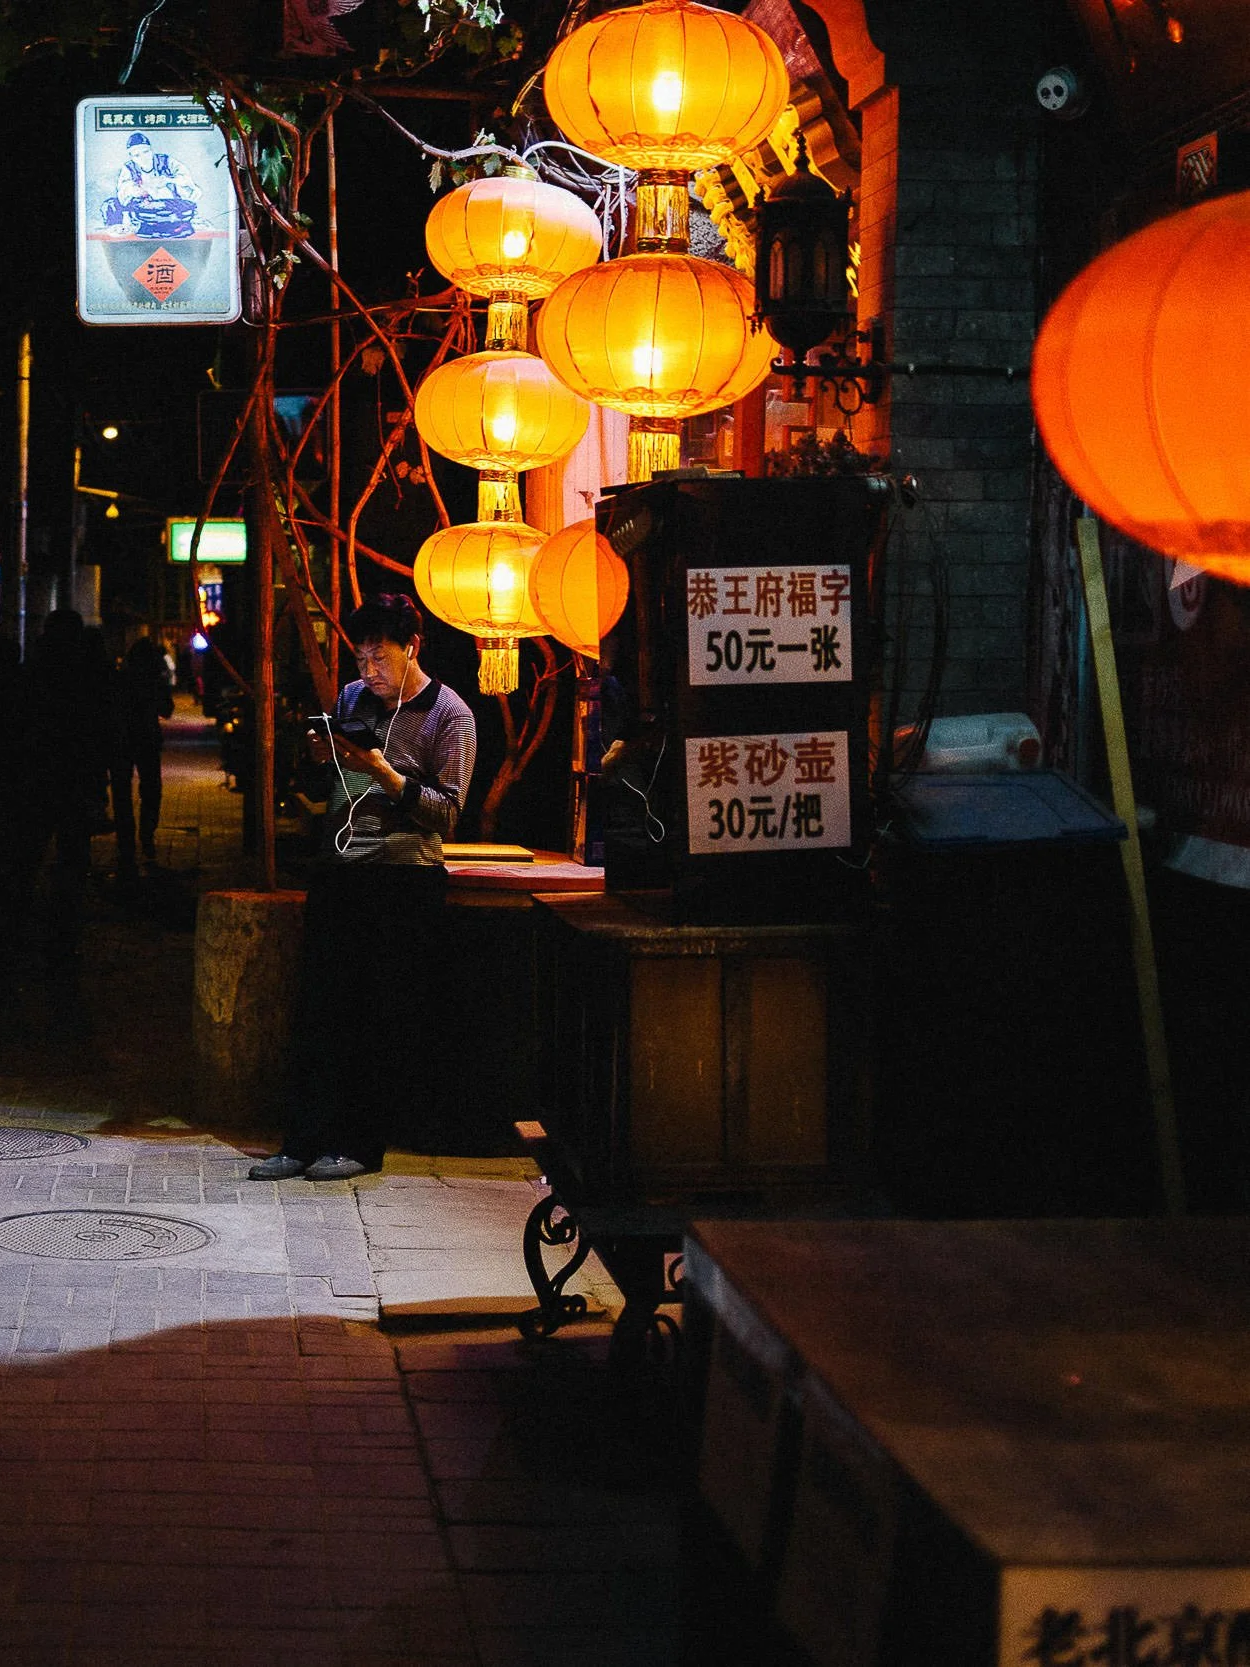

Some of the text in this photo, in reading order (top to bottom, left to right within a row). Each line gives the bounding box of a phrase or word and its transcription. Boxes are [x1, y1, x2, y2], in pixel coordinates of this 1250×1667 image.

[147, 264, 176, 284] 酒
[688, 569, 851, 619] 恭王府福字
[706, 625, 842, 673] 50元一张
[698, 737, 836, 789] 紫砂壶
[707, 793, 825, 840] 30元/把
[1020, 1604, 1250, 1667] 老北京
